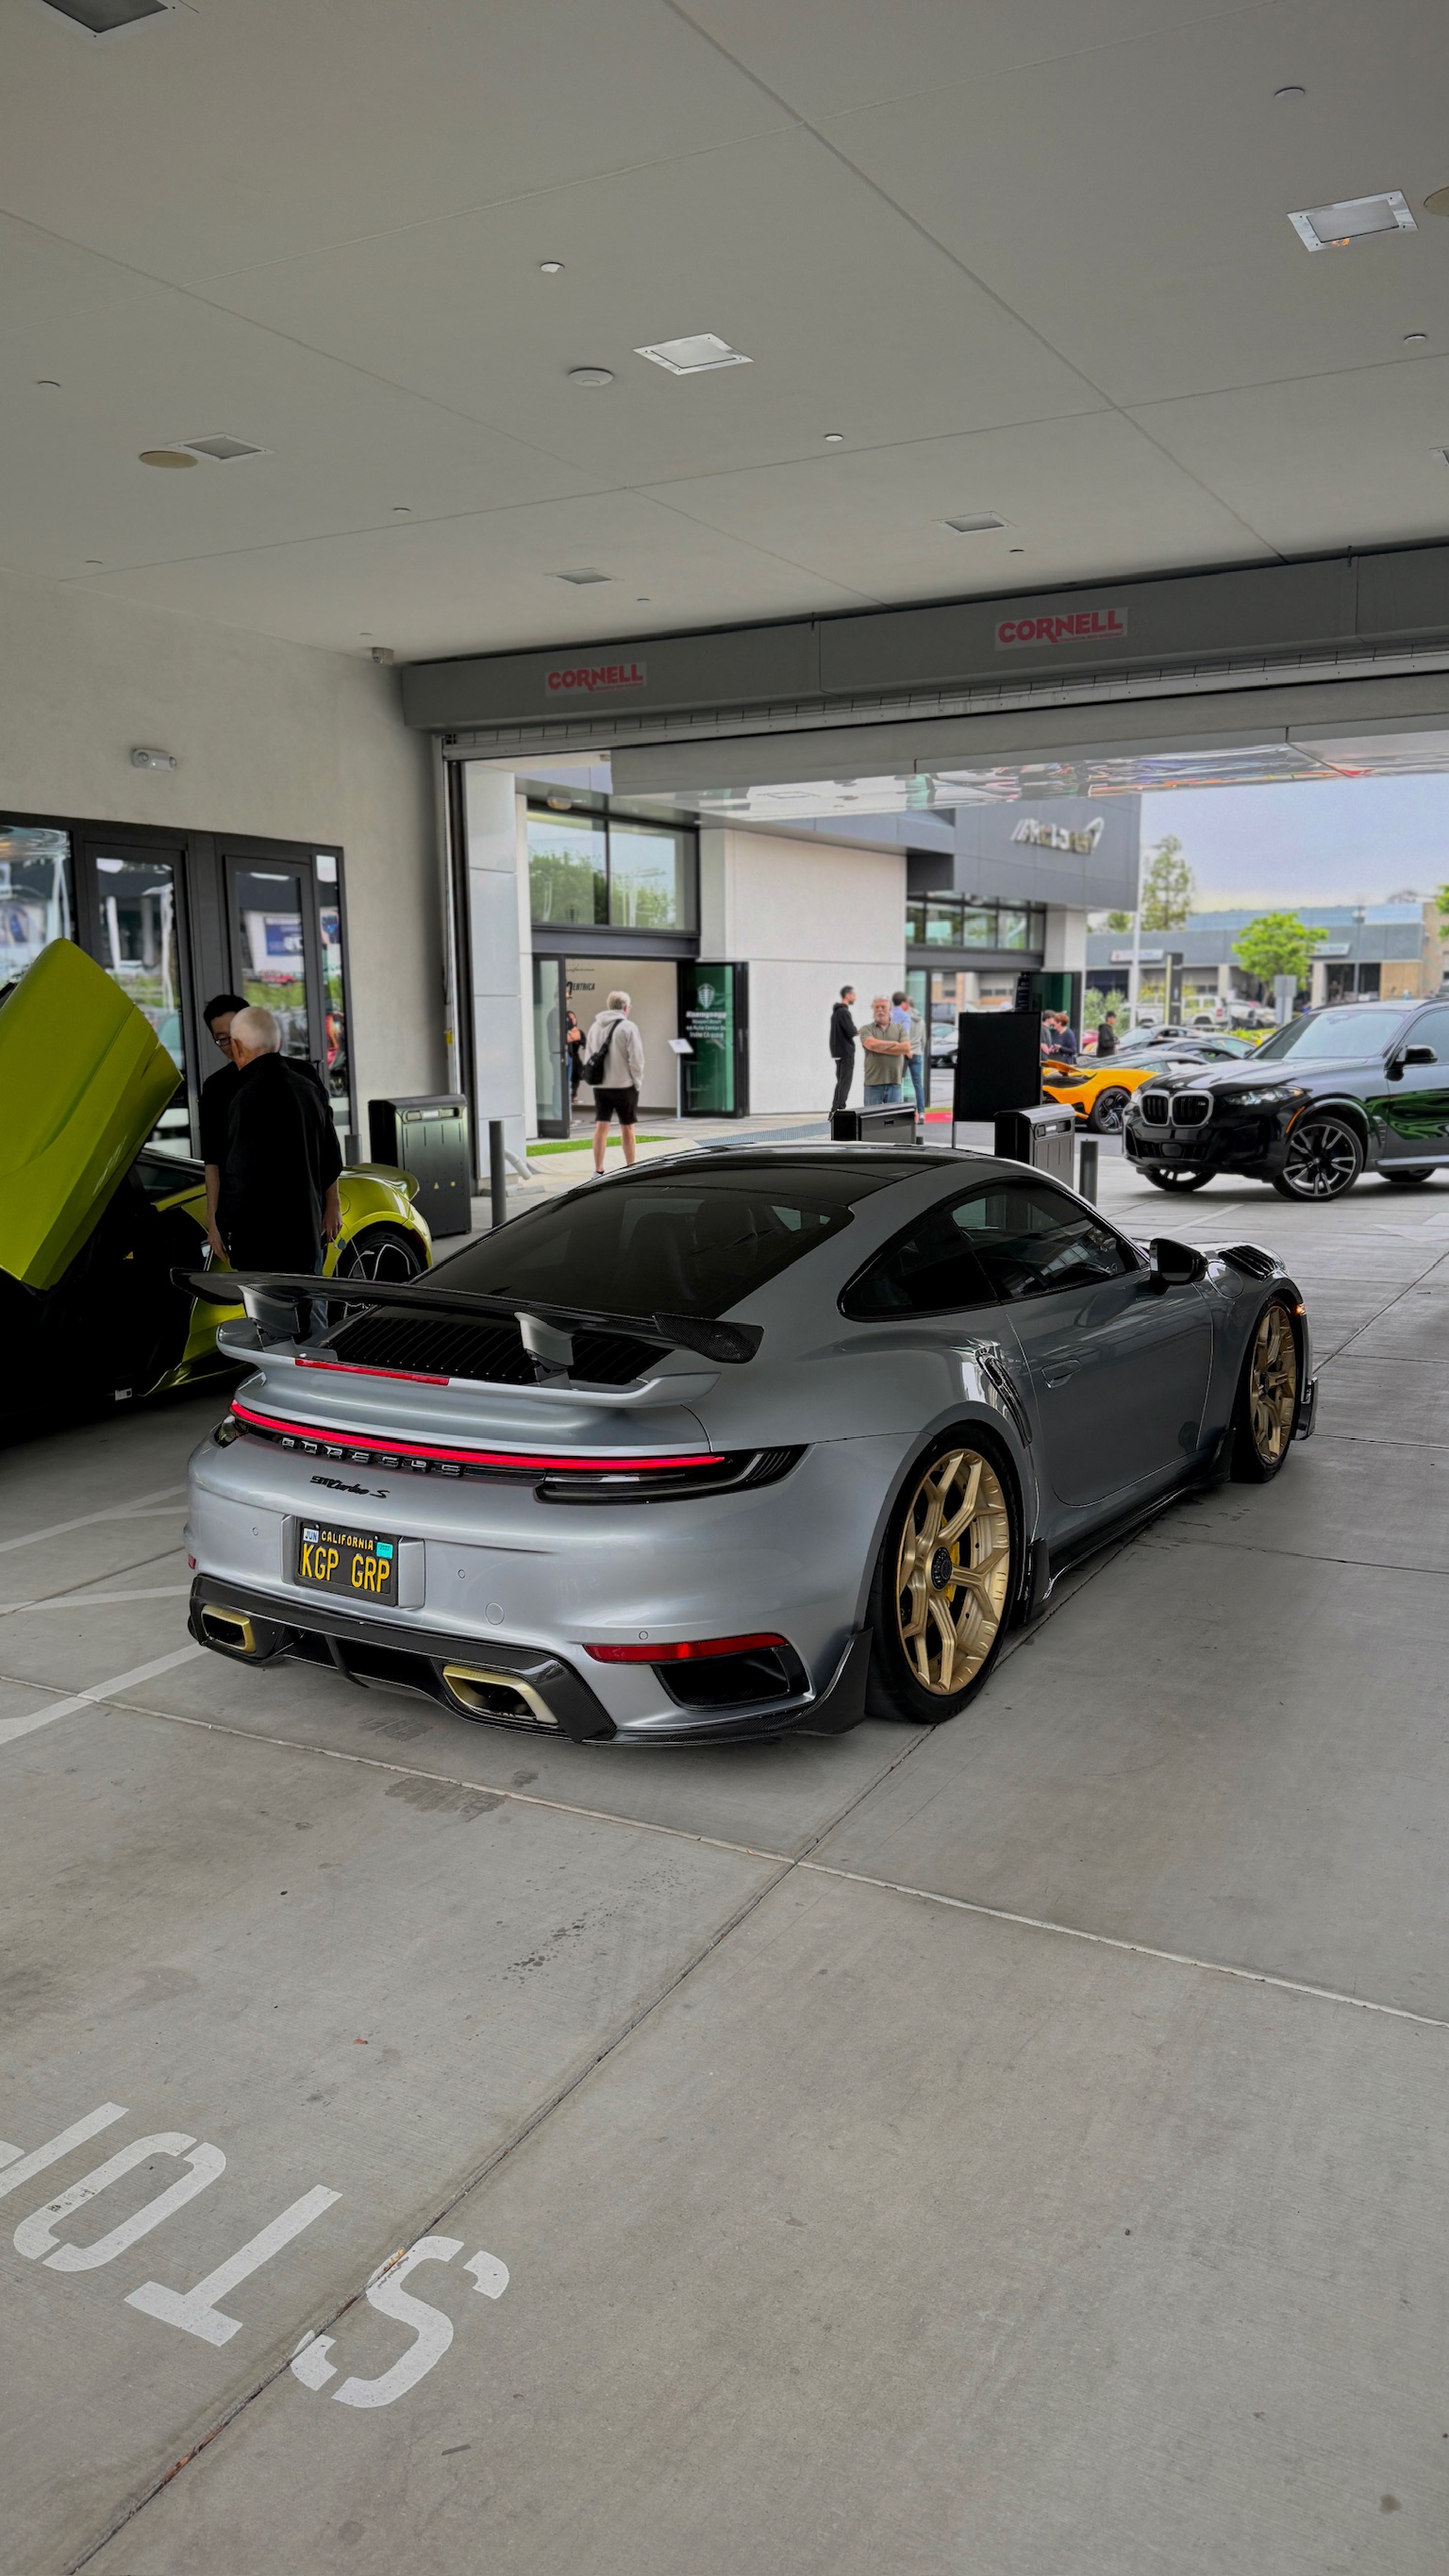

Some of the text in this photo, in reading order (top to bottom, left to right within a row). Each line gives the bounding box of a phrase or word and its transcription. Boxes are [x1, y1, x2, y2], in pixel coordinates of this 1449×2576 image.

[998, 610, 1124, 644] CORNELL
[548, 663, 643, 692] CORNELL
[282, 1437, 461, 1477] PORSCHE
[305, 1530, 317, 1541] JUN
[321, 1531, 374, 1550] CALIFORNIA
[302, 1543, 391, 1593] KGP GRP
